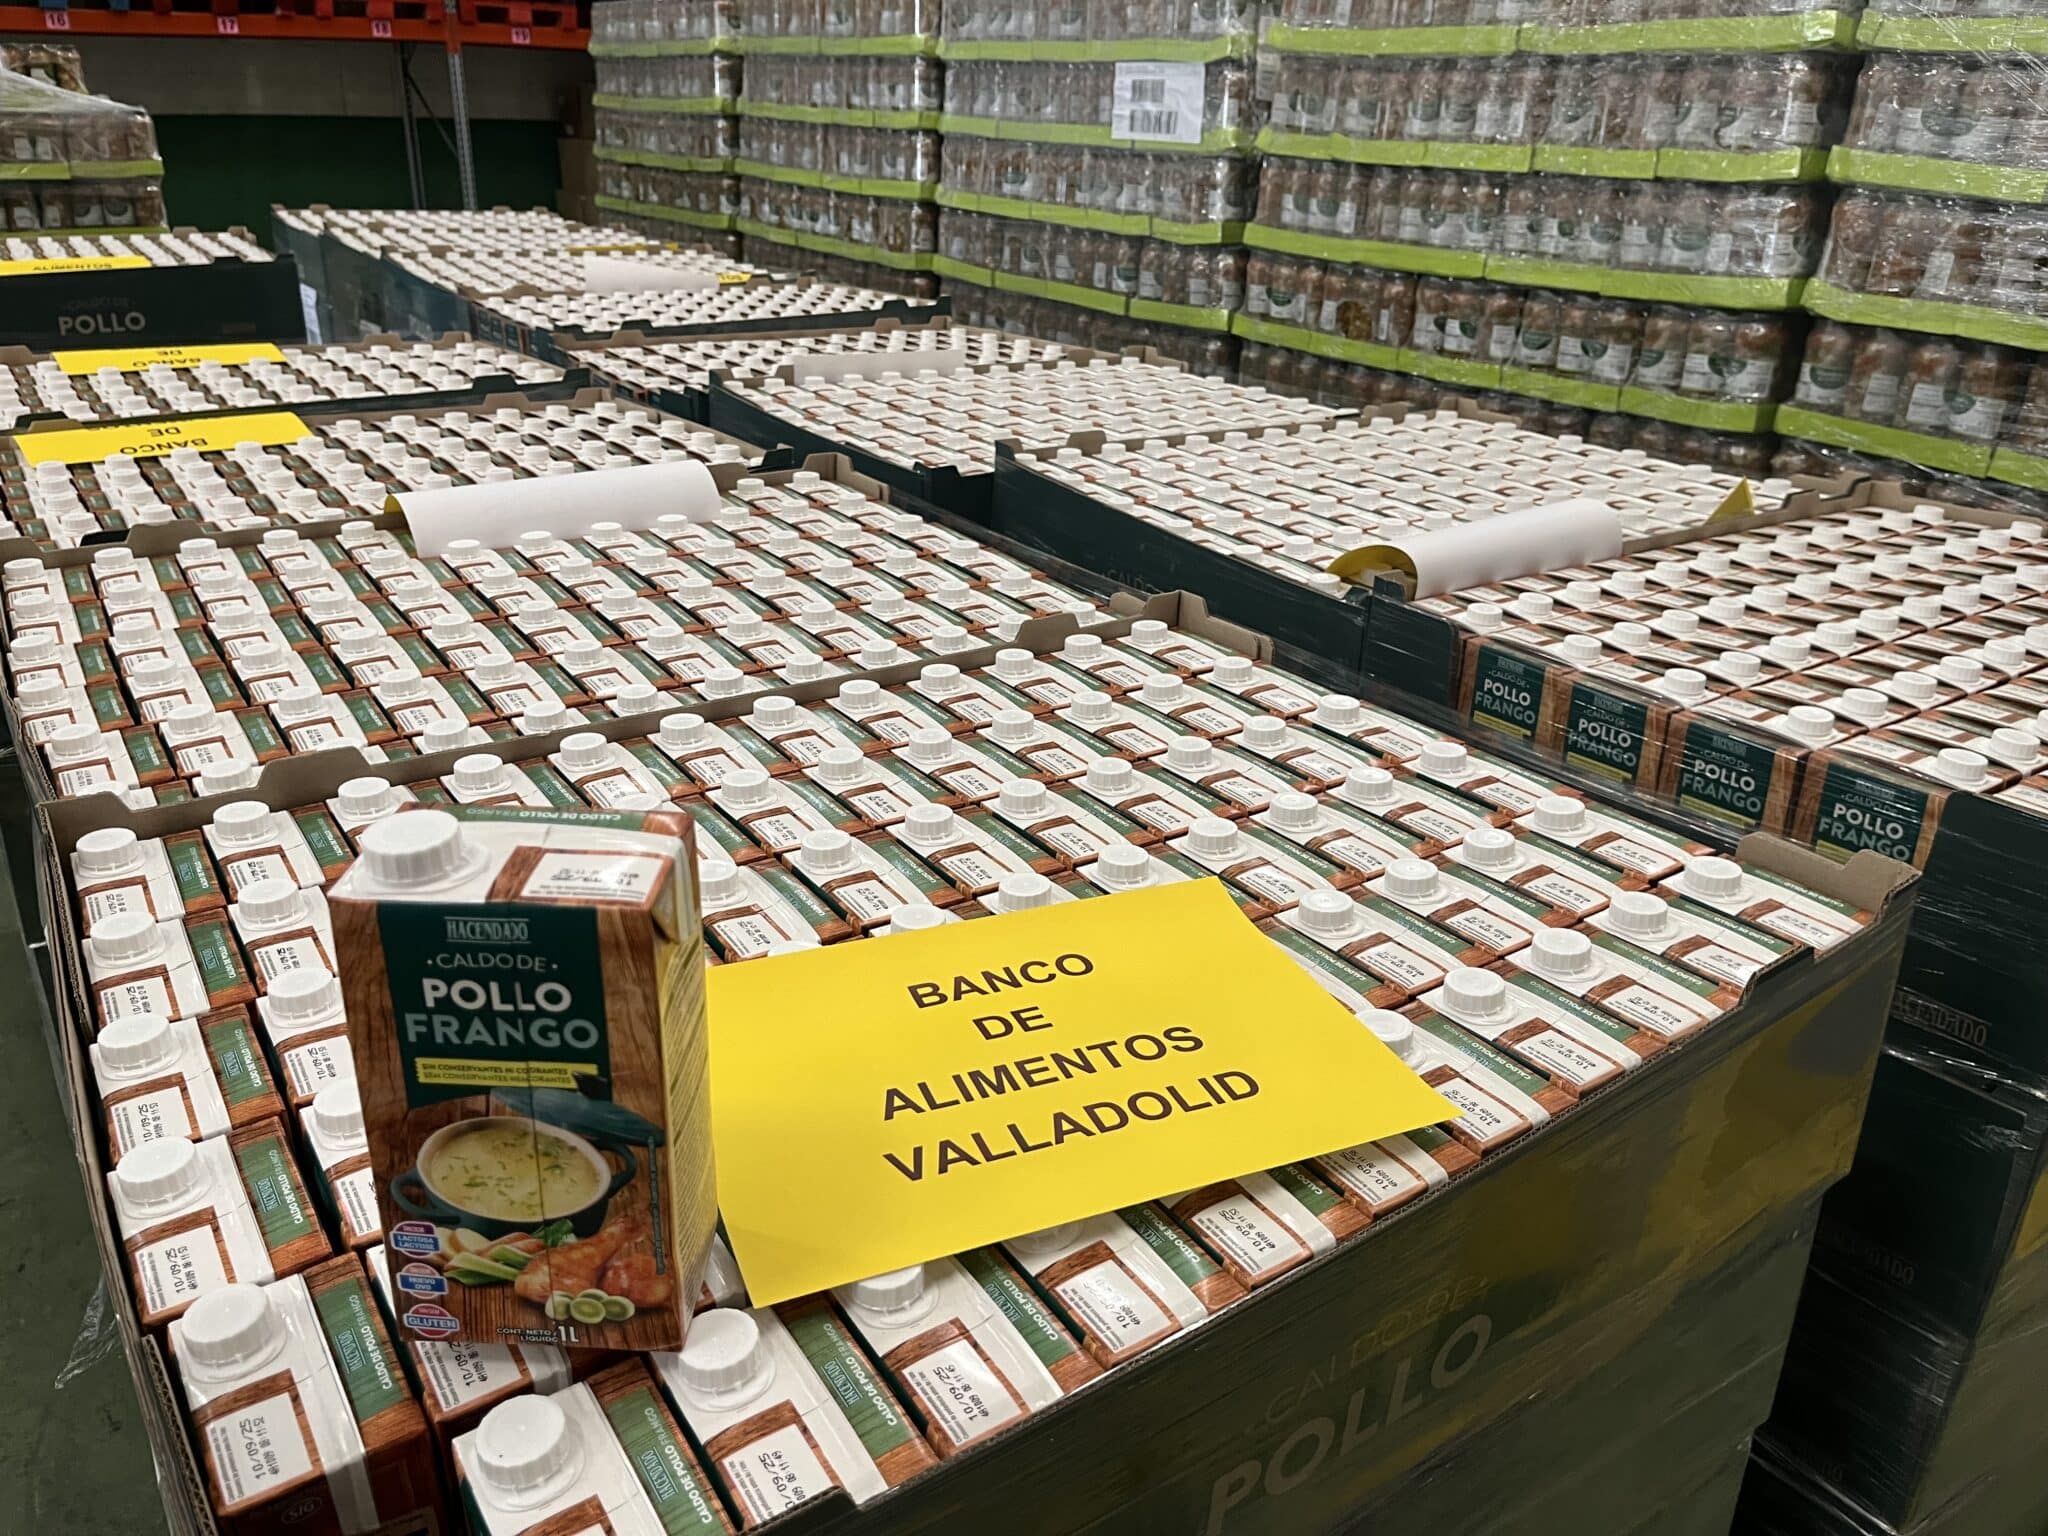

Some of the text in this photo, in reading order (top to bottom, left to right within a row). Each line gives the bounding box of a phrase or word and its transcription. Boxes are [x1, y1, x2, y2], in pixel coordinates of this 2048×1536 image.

[48, 12, 67, 27] 16
[220, 17, 237, 32] 17
[58, 311, 146, 336] POLLO
[147, 426, 181, 437] DE
[119, 438, 209, 455] BANCO
[1484, 679, 1531, 706] POLLO
[1475, 691, 1535, 724] FRANGO
[1578, 719, 1631, 747] POLLO
[1568, 731, 1636, 766] FRANGO
[1694, 759, 1755, 792] POLLO
[1682, 774, 1761, 813] FRANGO
[520, 810, 559, 819] POLLO
[561, 811, 577, 820] DE
[580, 812, 621, 821] CALDO
[1833, 803, 1903, 840] POLLO
[1819, 817, 1910, 861] FRANGO
[446, 918, 528, 941] HACENDADO
[436, 952, 547, 972] CALDO DE
[422, 978, 572, 1012] POLLO
[907, 953, 1094, 1009] BANCO
[1558, 995, 1582, 1011] POLLO
[1581, 1007, 1593, 1016] DE
[403, 1013, 599, 1049] FRANGO
[972, 1006, 1053, 1041] DE
[1592, 1012, 1618, 1030] CALDO
[306, 1046, 327, 1080] 10/09/25
[1471, 1040, 1496, 1059] POLLO
[1494, 1055, 1506, 1065] DE
[883, 1026, 1204, 1121] ALIMENTOS
[1505, 1062, 1531, 1081] CALDO
[137, 1103, 154, 1142] 10/09/25
[882, 1071, 1260, 1182] VALLADOLID
[275, 1173, 292, 1195] POLLO
[1339, 1149, 1389, 1190] 10/09/25
[283, 1192, 296, 1204] DE
[287, 1201, 305, 1224] CALDO
[1163, 1227, 1177, 1241] DE
[1217, 1206, 1266, 1253] 10/09/25
[1173, 1237, 1201, 1264] CALDO
[164, 1246, 186, 1293] 10/09/25
[408, 1317, 457, 1329] GLUTEN
[1002, 1276, 1058, 1342] CALDO DE POLLO
[359, 1324, 377, 1351] POLLO
[558, 1325, 580, 1343] 1L
[369, 1349, 382, 1362] DE
[445, 1337, 477, 1386] 10/09/2
[844, 1354, 869, 1385] POLLO
[373, 1360, 393, 1390] CALDO
[863, 1381, 877, 1397] DE
[932, 1364, 978, 1422] 10/09/25
[871, 1394, 898, 1427] CALDO
[1206, 1313, 1493, 1536] POLLO
[237, 1418, 267, 1480] 10/09/25
[663, 1443, 688, 1477] POLLO
[639, 1448, 675, 1500] HACENDADO
[679, 1474, 695, 1491] DE
[752, 1450, 800, 1509] 0/09/25
[687, 1488, 713, 1525] CALDO
